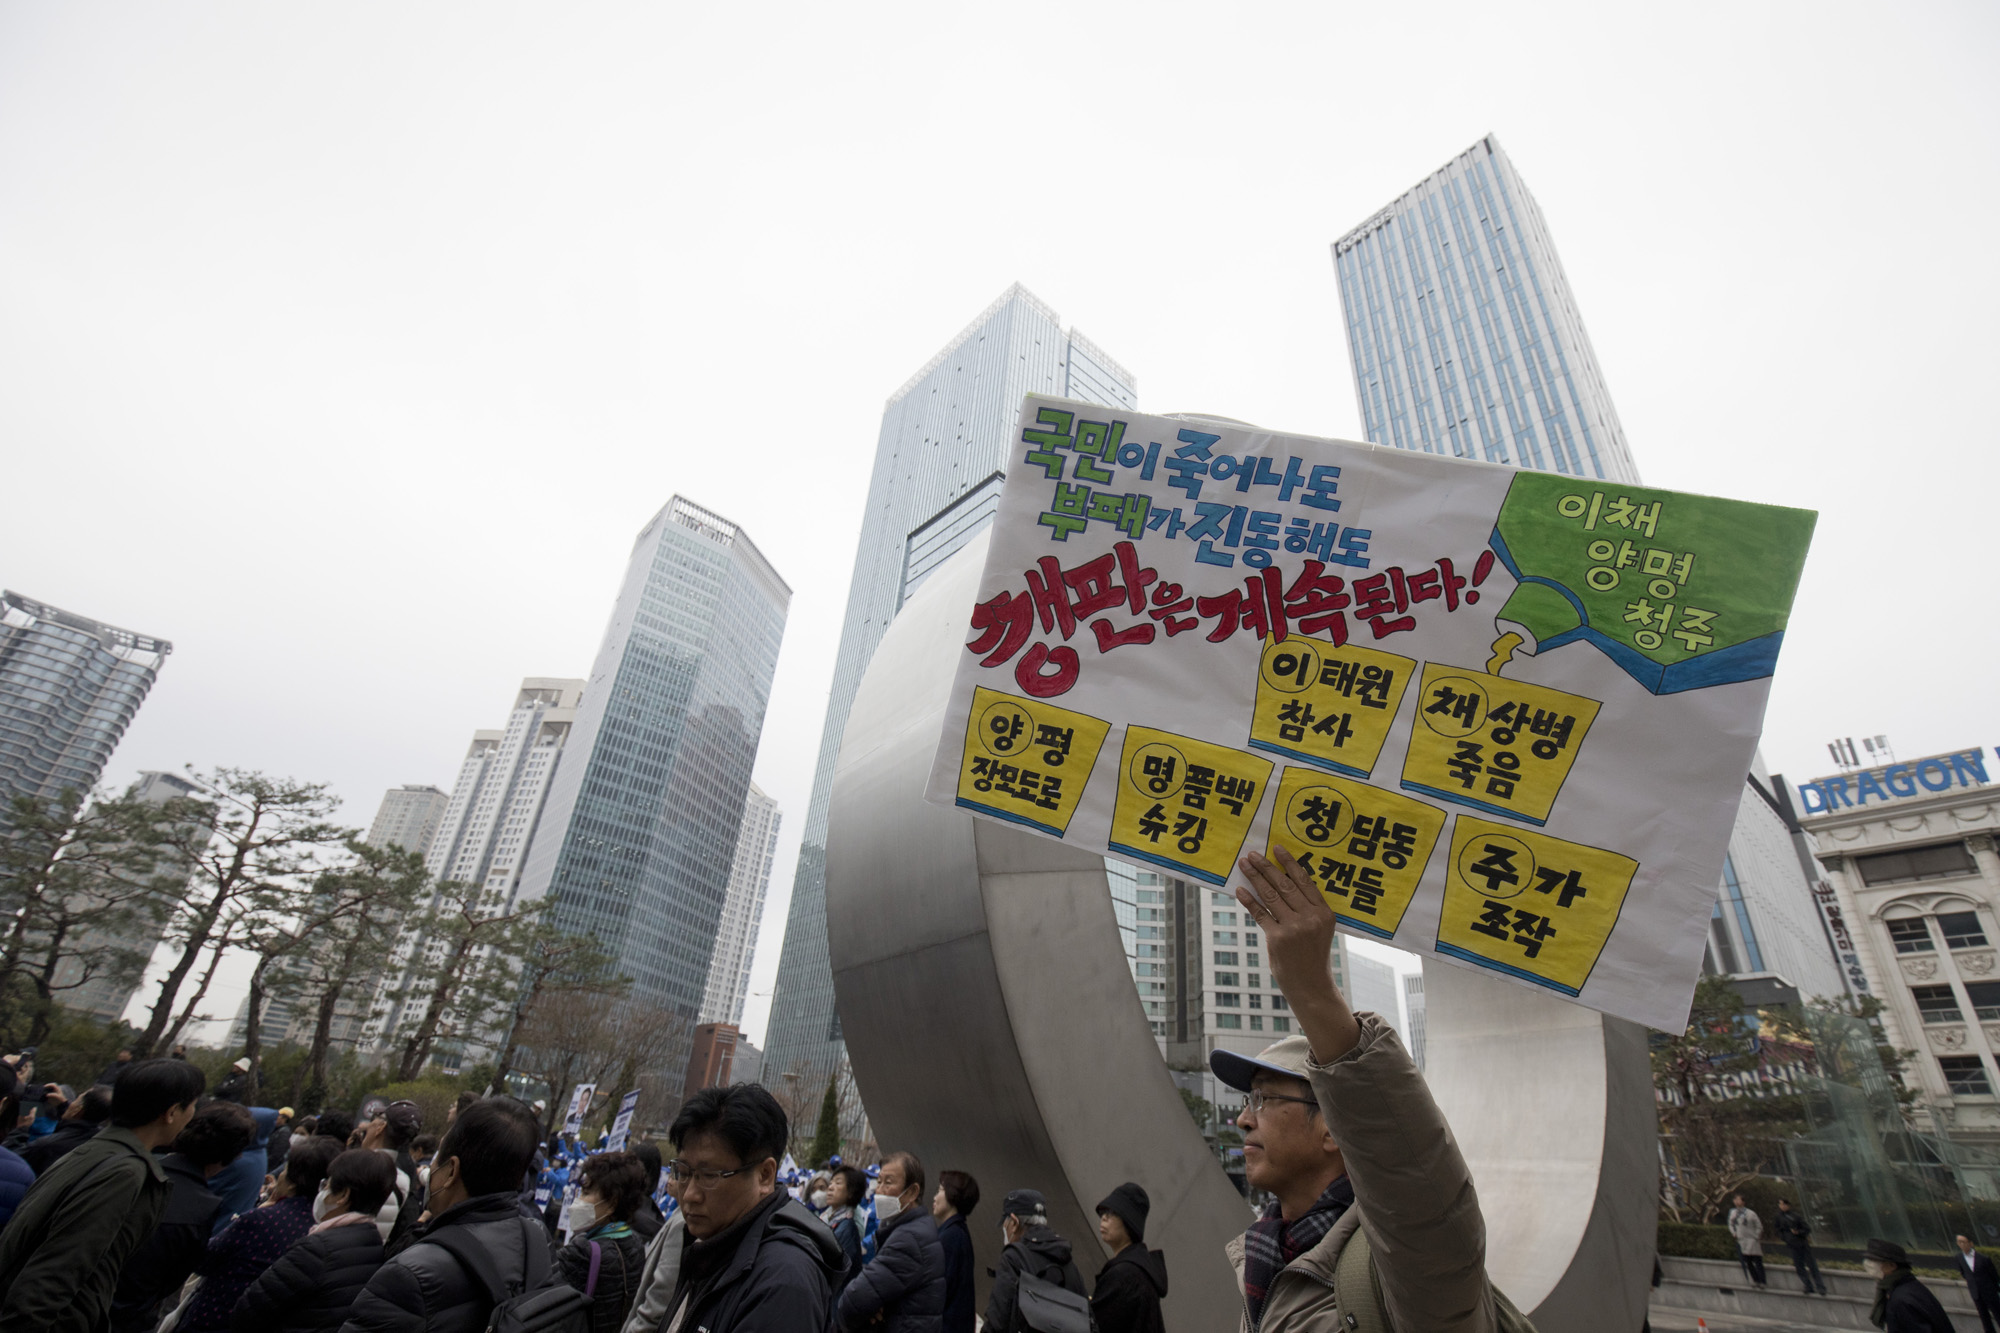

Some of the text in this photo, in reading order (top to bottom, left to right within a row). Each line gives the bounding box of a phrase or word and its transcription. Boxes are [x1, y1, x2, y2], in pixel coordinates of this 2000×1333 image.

[1022, 407, 1342, 512] 국민이 죽어나도
[1037, 481, 1373, 568] 부패가 진동해도
[1557, 491, 1663, 539] 이채
[1585, 540, 1696, 600] 양명
[966, 541, 1495, 697] 깽판은 계속된다!
[1623, 598, 1721, 652] 청주
[1277, 699, 1354, 748] 참사
[970, 755, 1063, 811] 장모도로
[1447, 740, 1522, 800] 죽음
[1798, 750, 1991, 815] DRAGON
[1138, 803, 1207, 854] 슈킹
[1470, 899, 1557, 959] 조작
